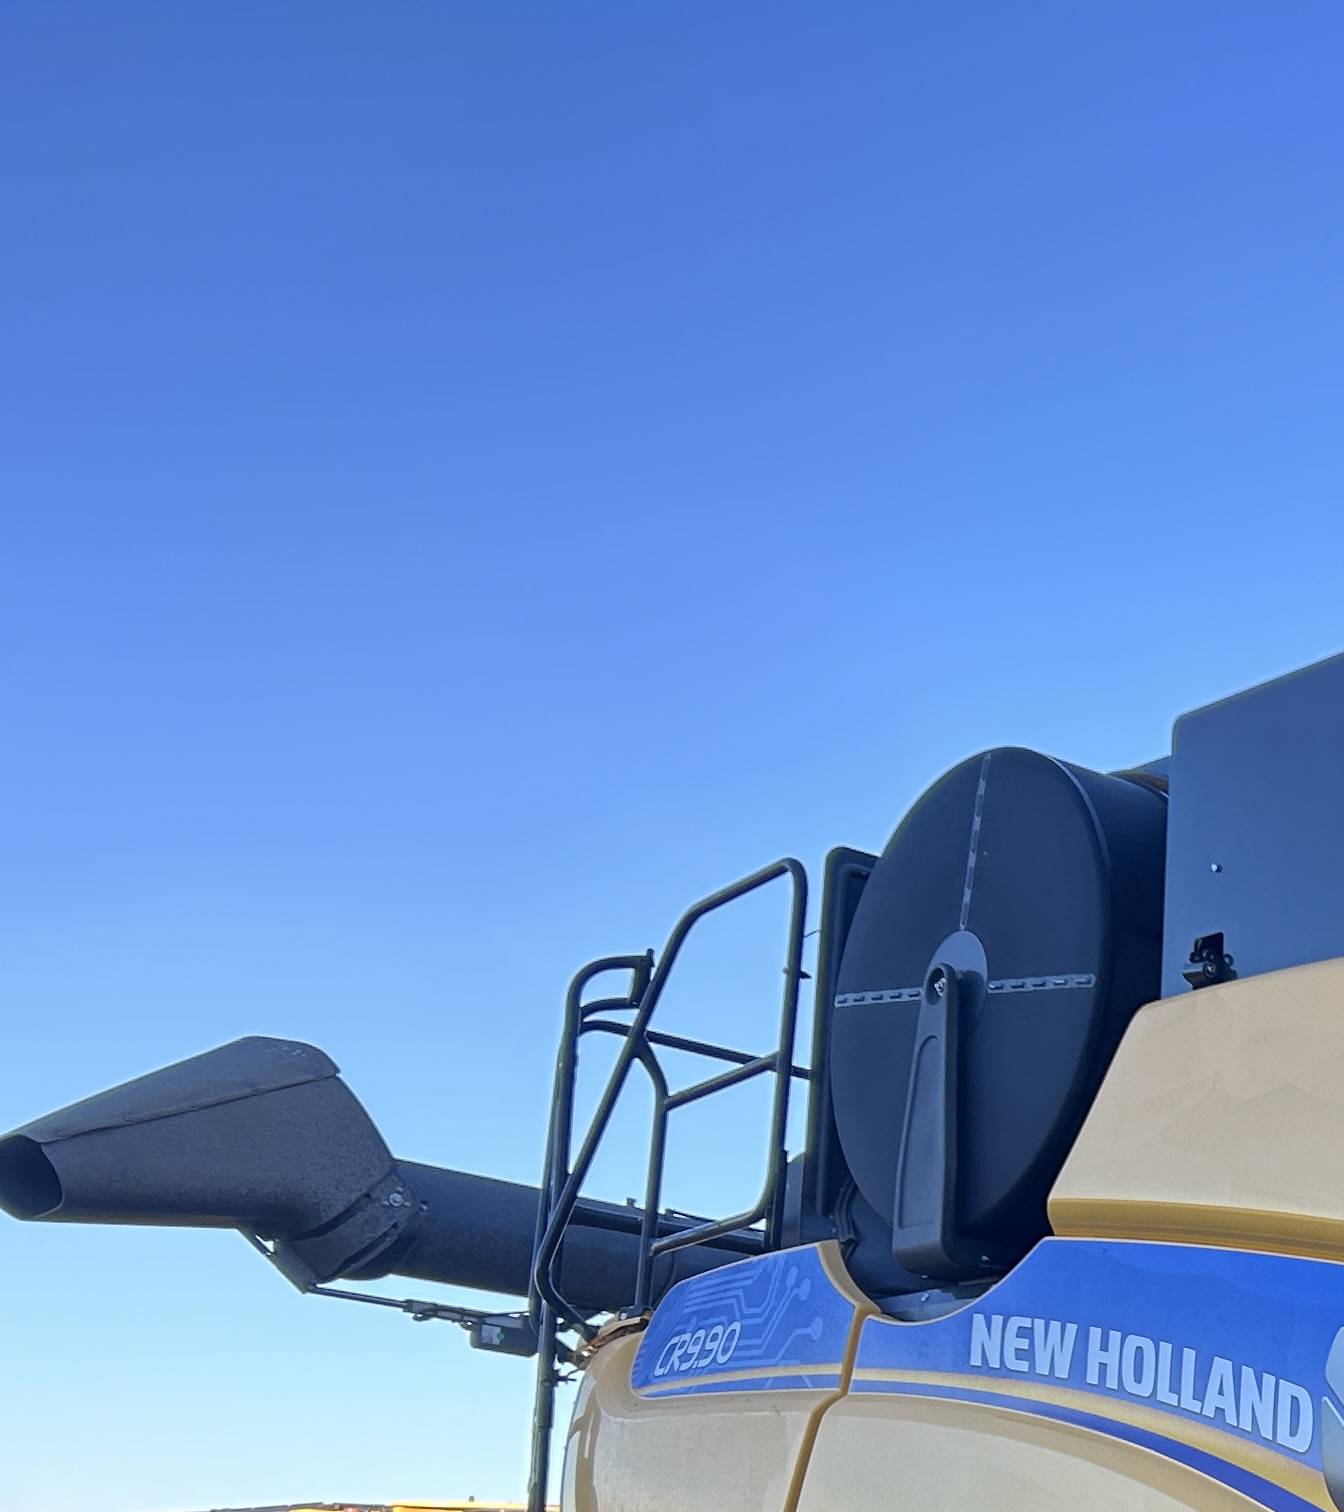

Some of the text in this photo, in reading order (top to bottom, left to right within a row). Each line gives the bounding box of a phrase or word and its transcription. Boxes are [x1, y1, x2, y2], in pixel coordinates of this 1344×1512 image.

[654, 1321, 742, 1376] CR9.90
[969, 1313, 1314, 1453] NEW HOLLAND
